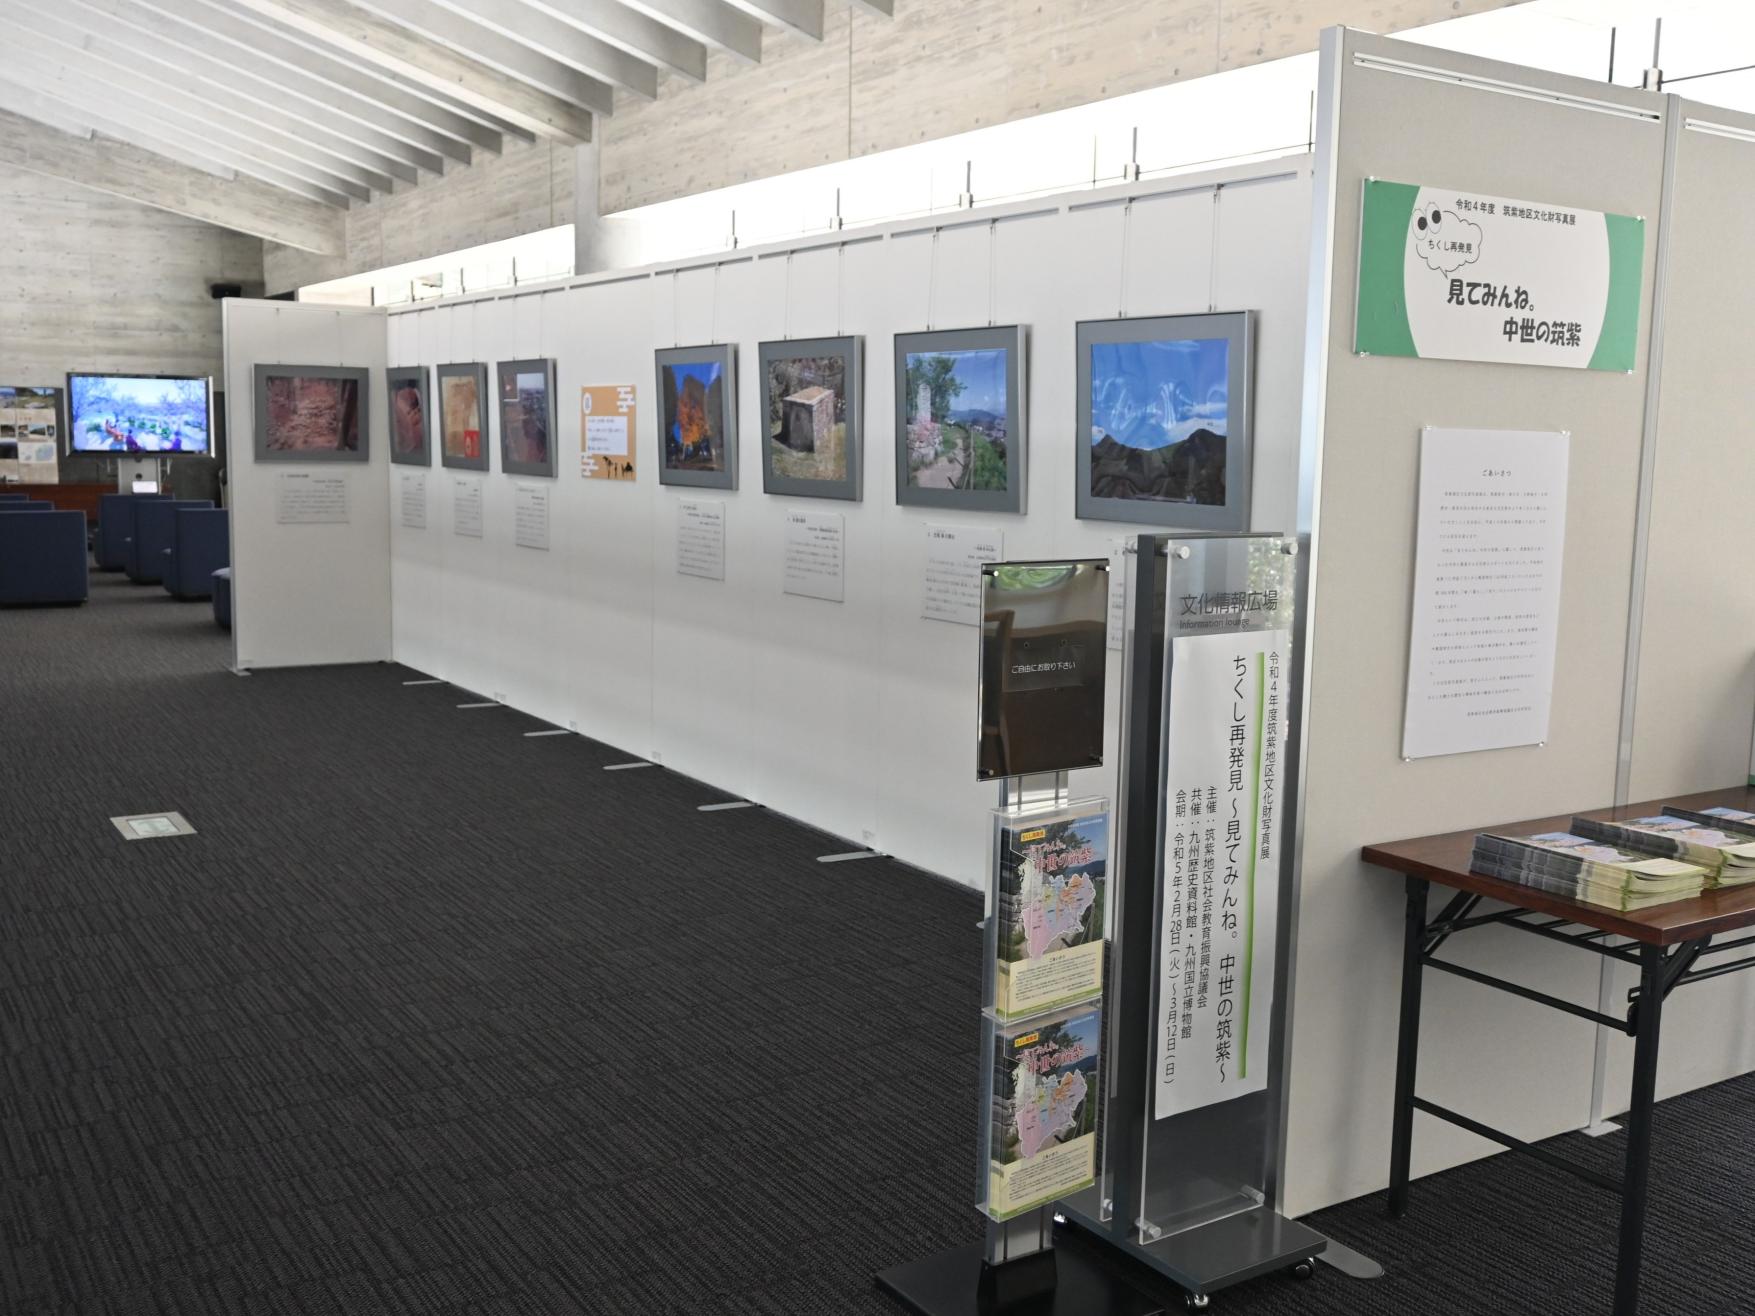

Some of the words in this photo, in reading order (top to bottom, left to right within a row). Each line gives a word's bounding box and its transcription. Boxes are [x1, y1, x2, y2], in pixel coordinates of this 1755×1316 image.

[1455, 199, 1496, 215] 令和4年度
[1428, 239, 1473, 254] ちくし再発見
[1447, 279, 1535, 312] 見てみんね。
[1503, 317, 1582, 347] 中世の筑紫
[1179, 590, 1278, 616] 文化情報広場
[1011, 661, 1076, 674] ご自由にお取り下さい
